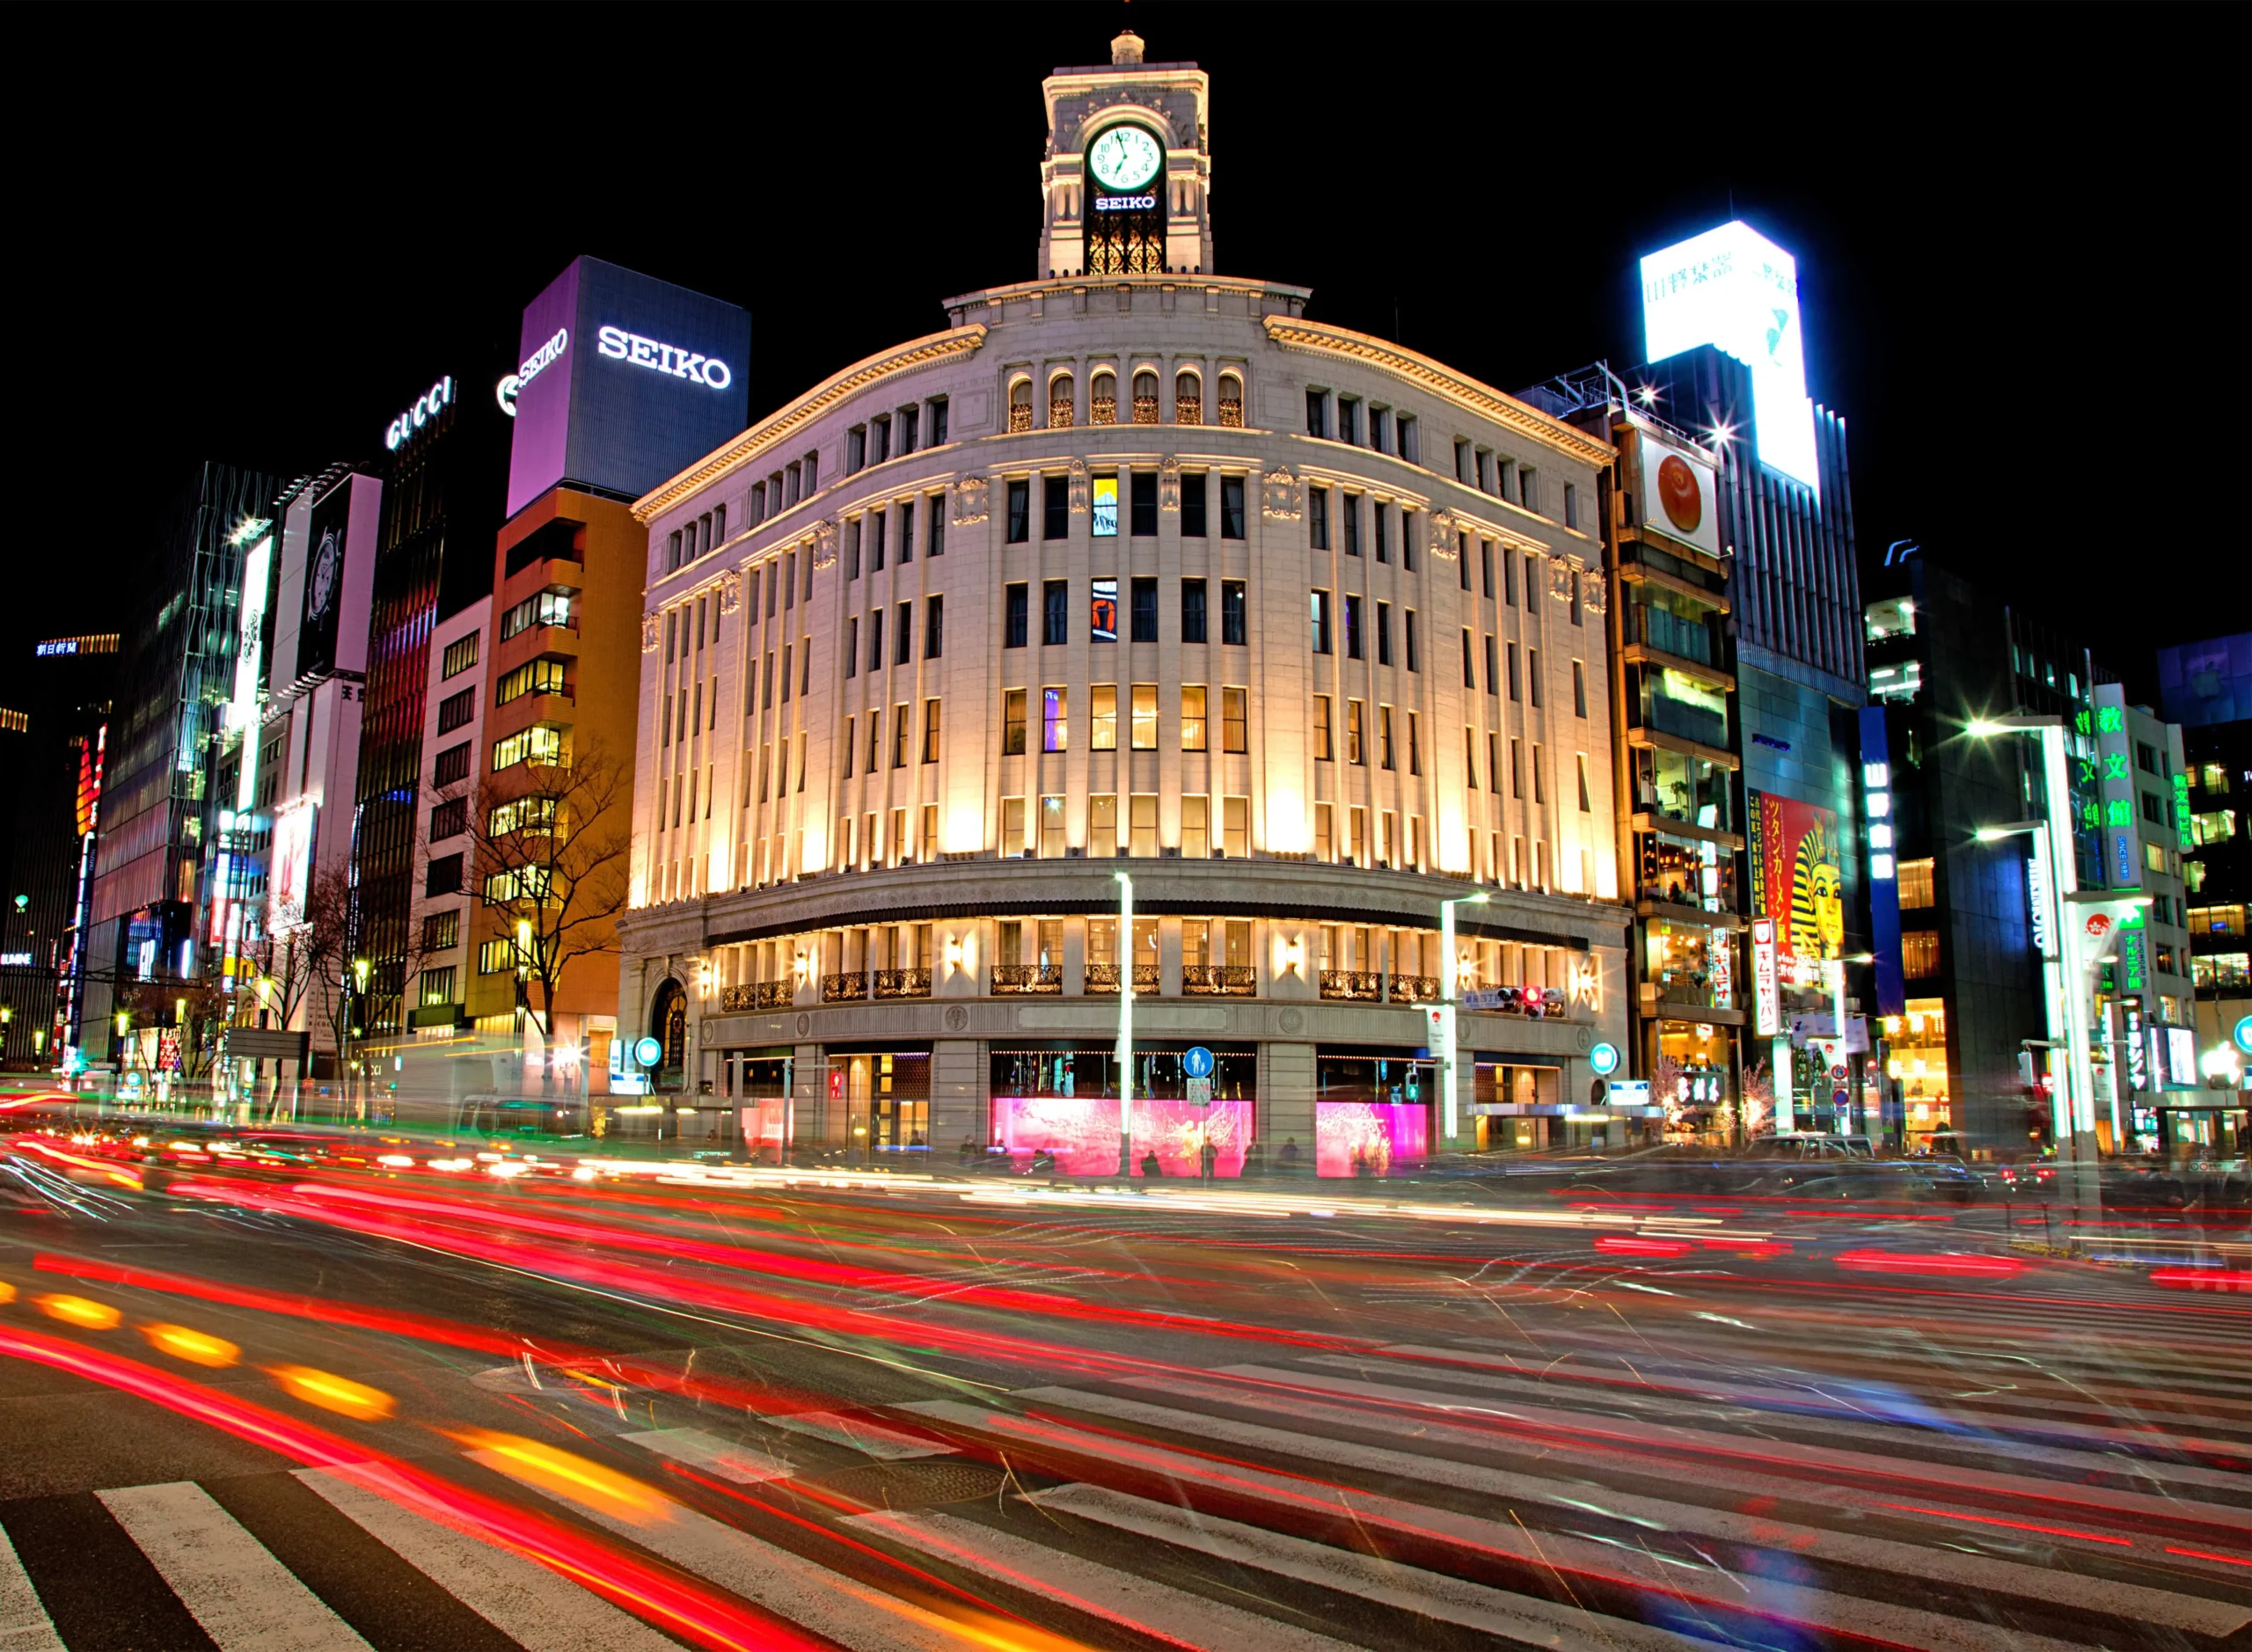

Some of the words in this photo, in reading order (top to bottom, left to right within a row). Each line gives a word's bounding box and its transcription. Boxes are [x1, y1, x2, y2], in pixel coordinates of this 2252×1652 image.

[1095, 196, 1156, 210] SEIKO
[518, 327, 568, 388] SEIKO
[598, 325, 732, 390] SEIKO
[385, 375, 452, 450] GUCCI
[37, 641, 77, 656] 朝日新聞
[2098, 705, 2132, 828] 教文館
[2117, 836, 2127, 860] SINCE
[361, 1064, 382, 1077] GCCI
